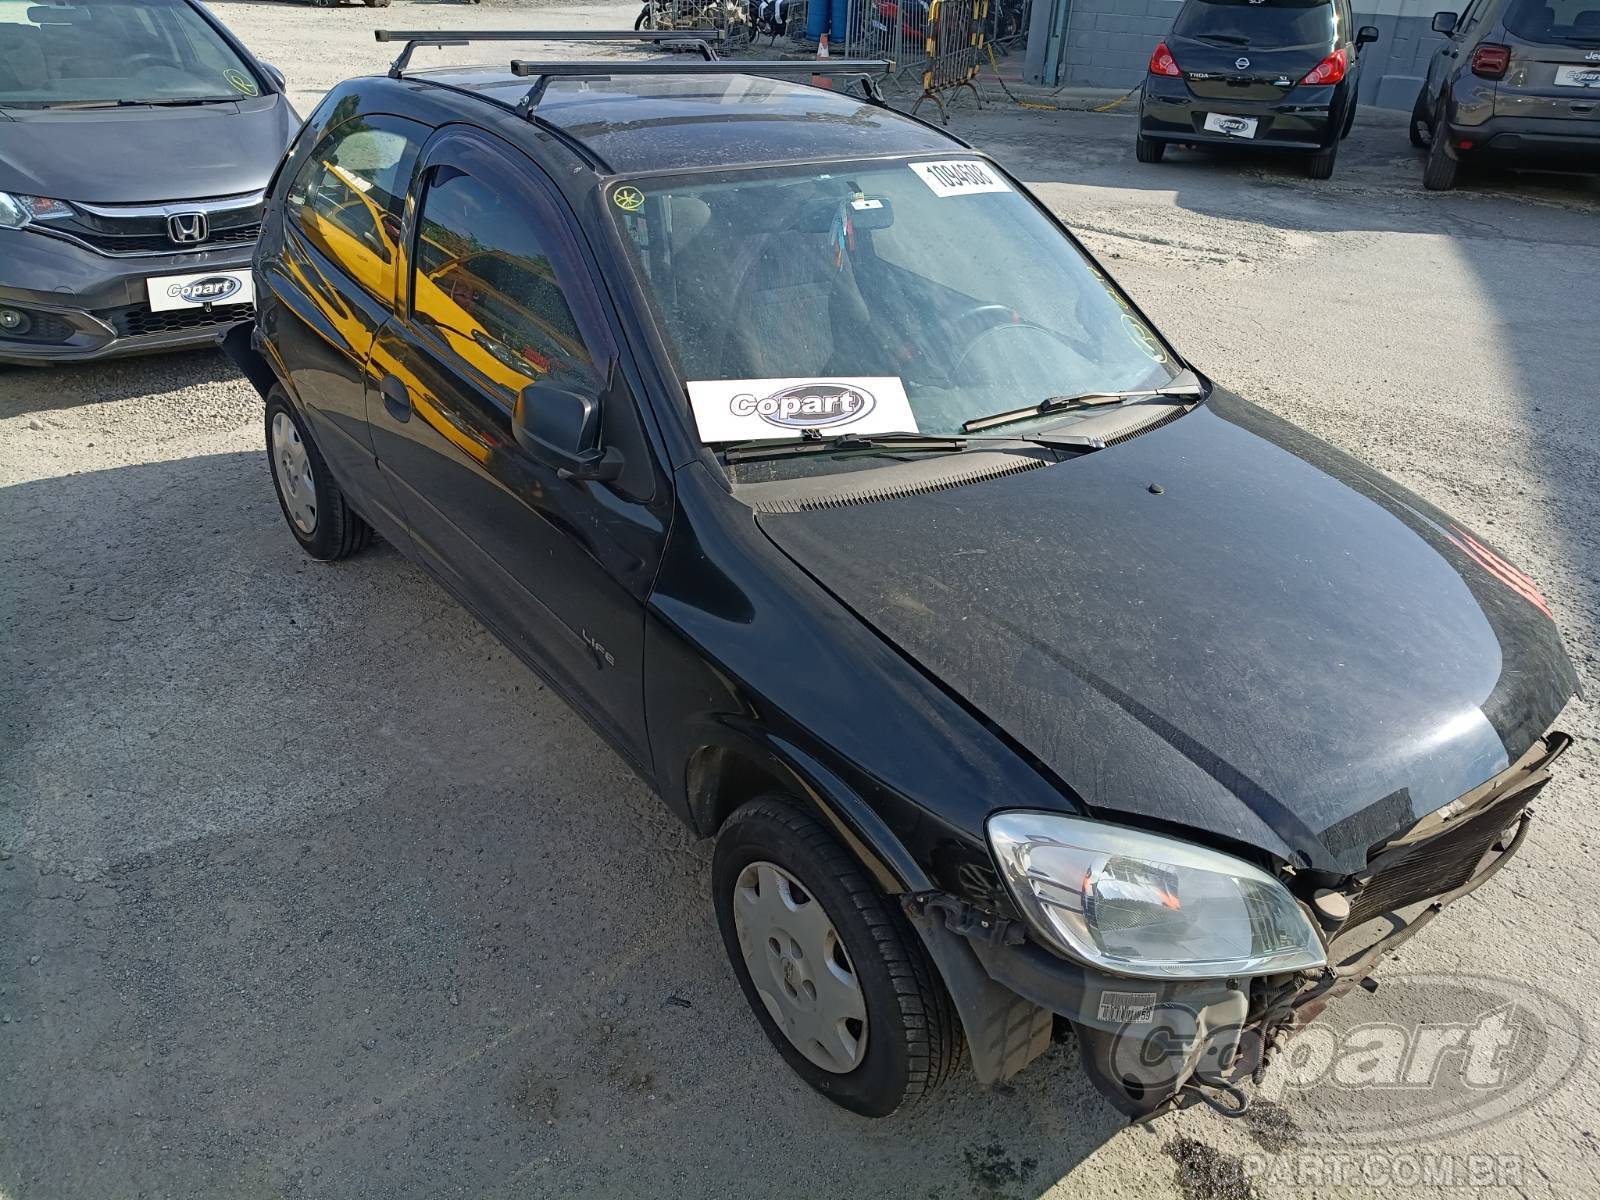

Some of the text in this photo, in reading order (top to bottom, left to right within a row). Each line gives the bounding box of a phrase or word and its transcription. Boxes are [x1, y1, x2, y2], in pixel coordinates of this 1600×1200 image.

[1567, 69, 1600, 82] Copar
[1214, 118, 1243, 131] Copart
[926, 163, 993, 188] 1094608
[166, 279, 232, 298] Copart
[729, 390, 856, 420] Copart
